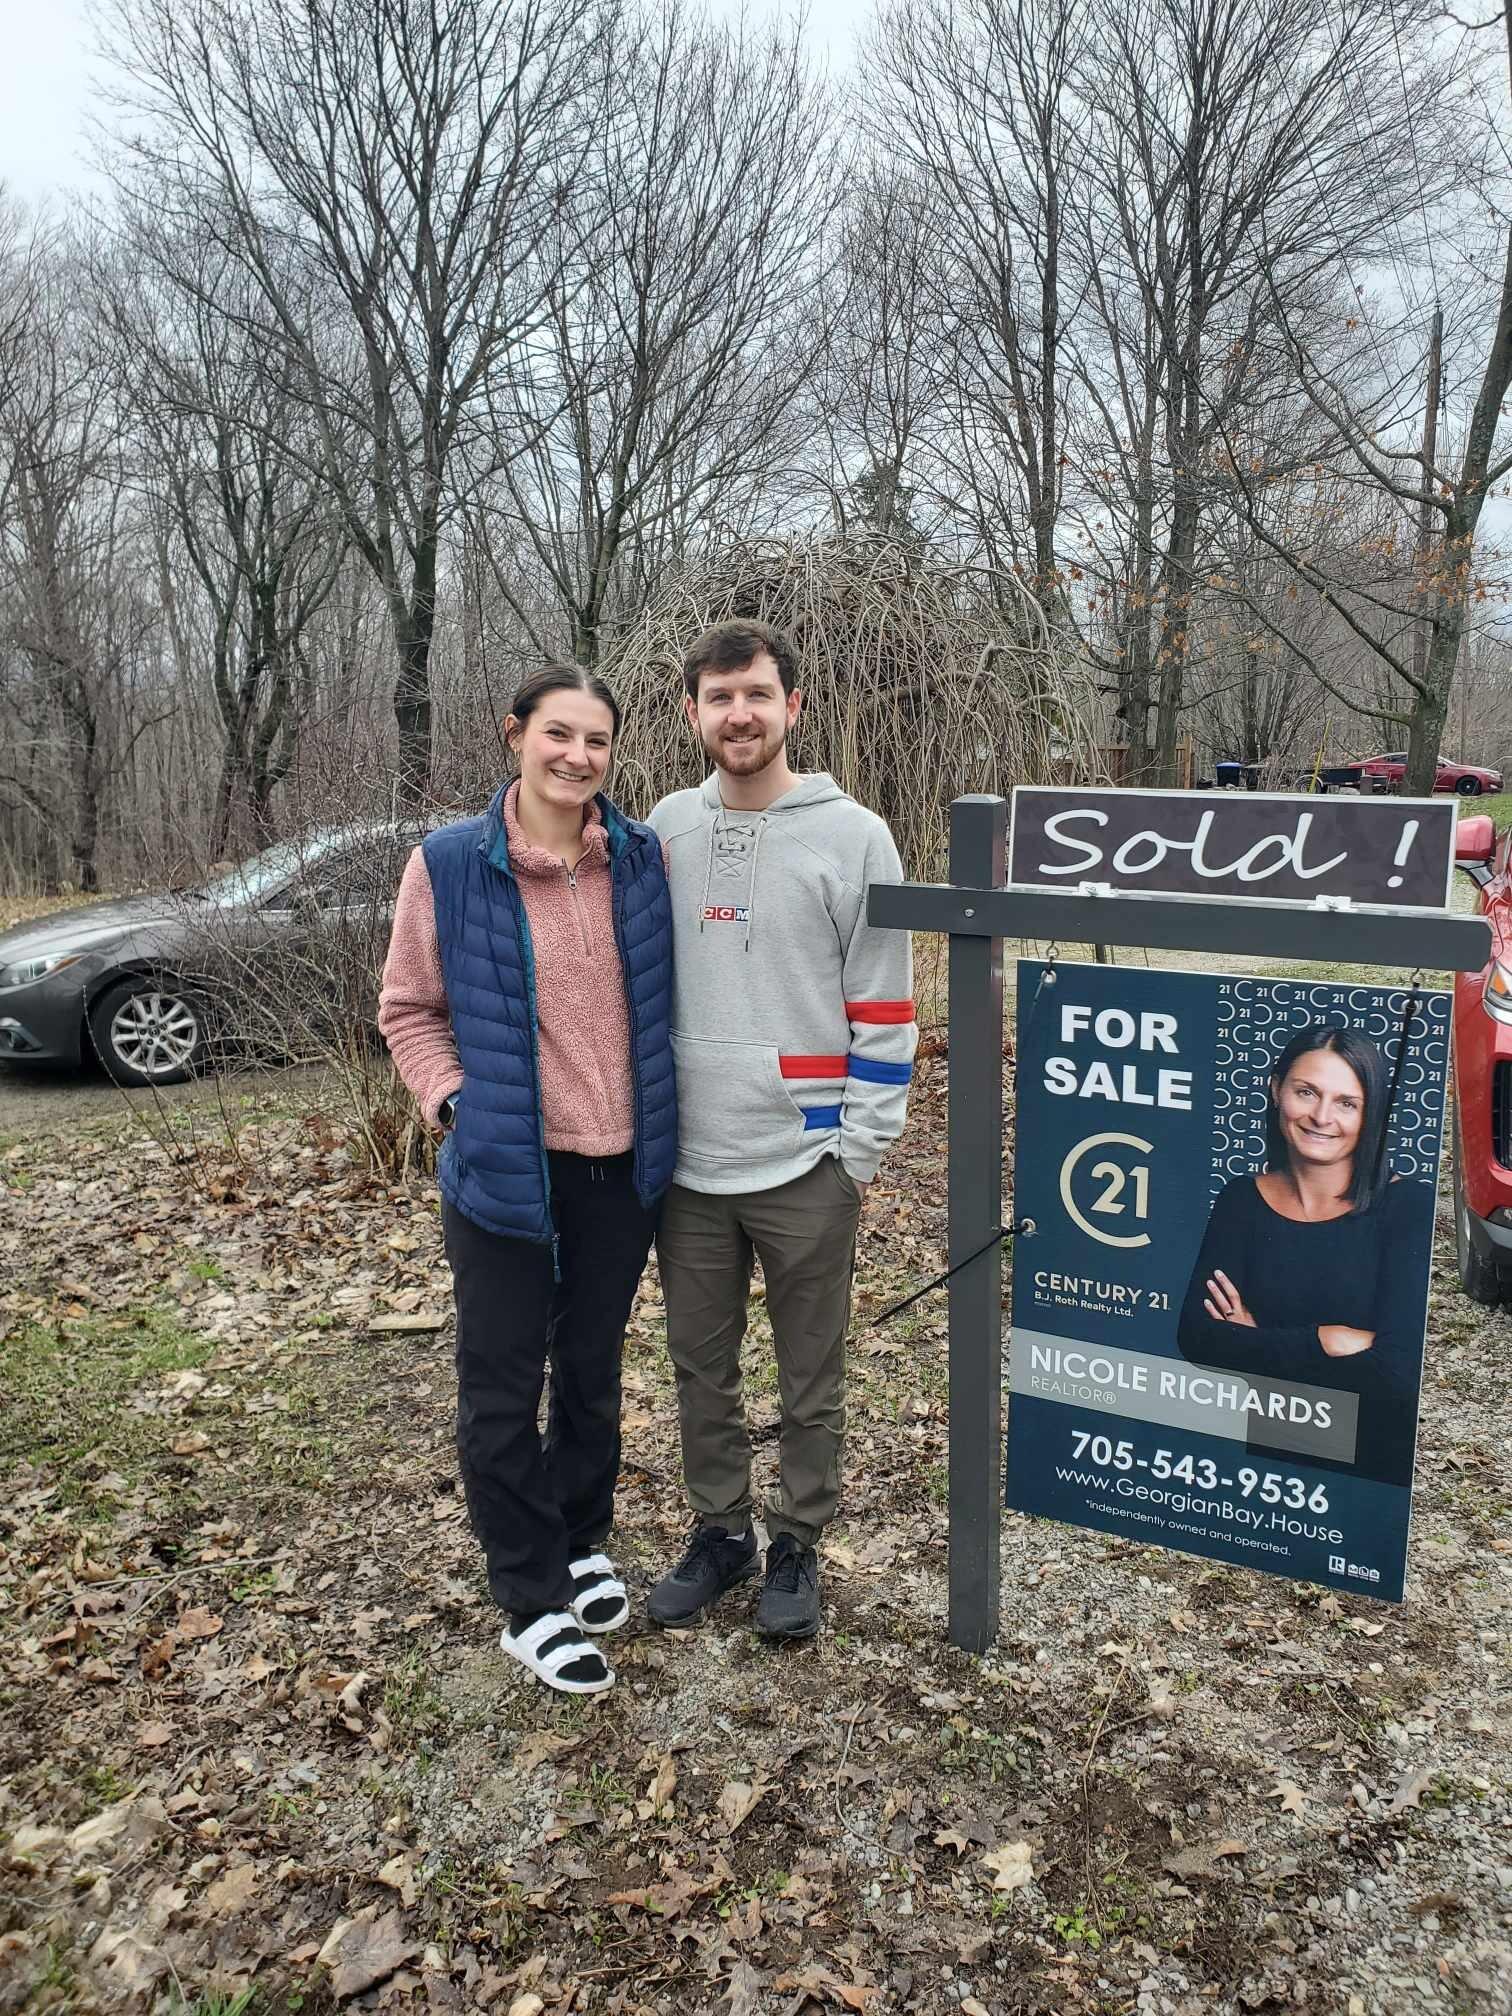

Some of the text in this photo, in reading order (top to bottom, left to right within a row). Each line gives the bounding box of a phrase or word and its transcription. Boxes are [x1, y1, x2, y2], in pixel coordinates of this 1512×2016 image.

[1039, 809, 1347, 881] Sold
[704, 908, 748, 921] CCM
[1061, 1004, 1180, 1054] FOR
[1043, 1057, 1193, 1110] SALE
[1090, 1161, 1149, 1219] 21
[1034, 1271, 1169, 1310] CENTURY 21
[1034, 1291, 1052, 1302] B.J.
[1055, 1295, 1078, 1307] Roth
[1080, 1300, 1112, 1314] Realty
[1114, 1306, 1134, 1318] Ltd.
[1031, 1344, 1332, 1429] NICOLE RICHARDS
[1071, 1430, 1329, 1514] 705-543-9536
[1055, 1466, 1344, 1544] www.GeorgianBay.House
[1168, 1519, 1207, 1536] owned
[1209, 1530, 1232, 1542] and
[1234, 1536, 1292, 1556] operated.
